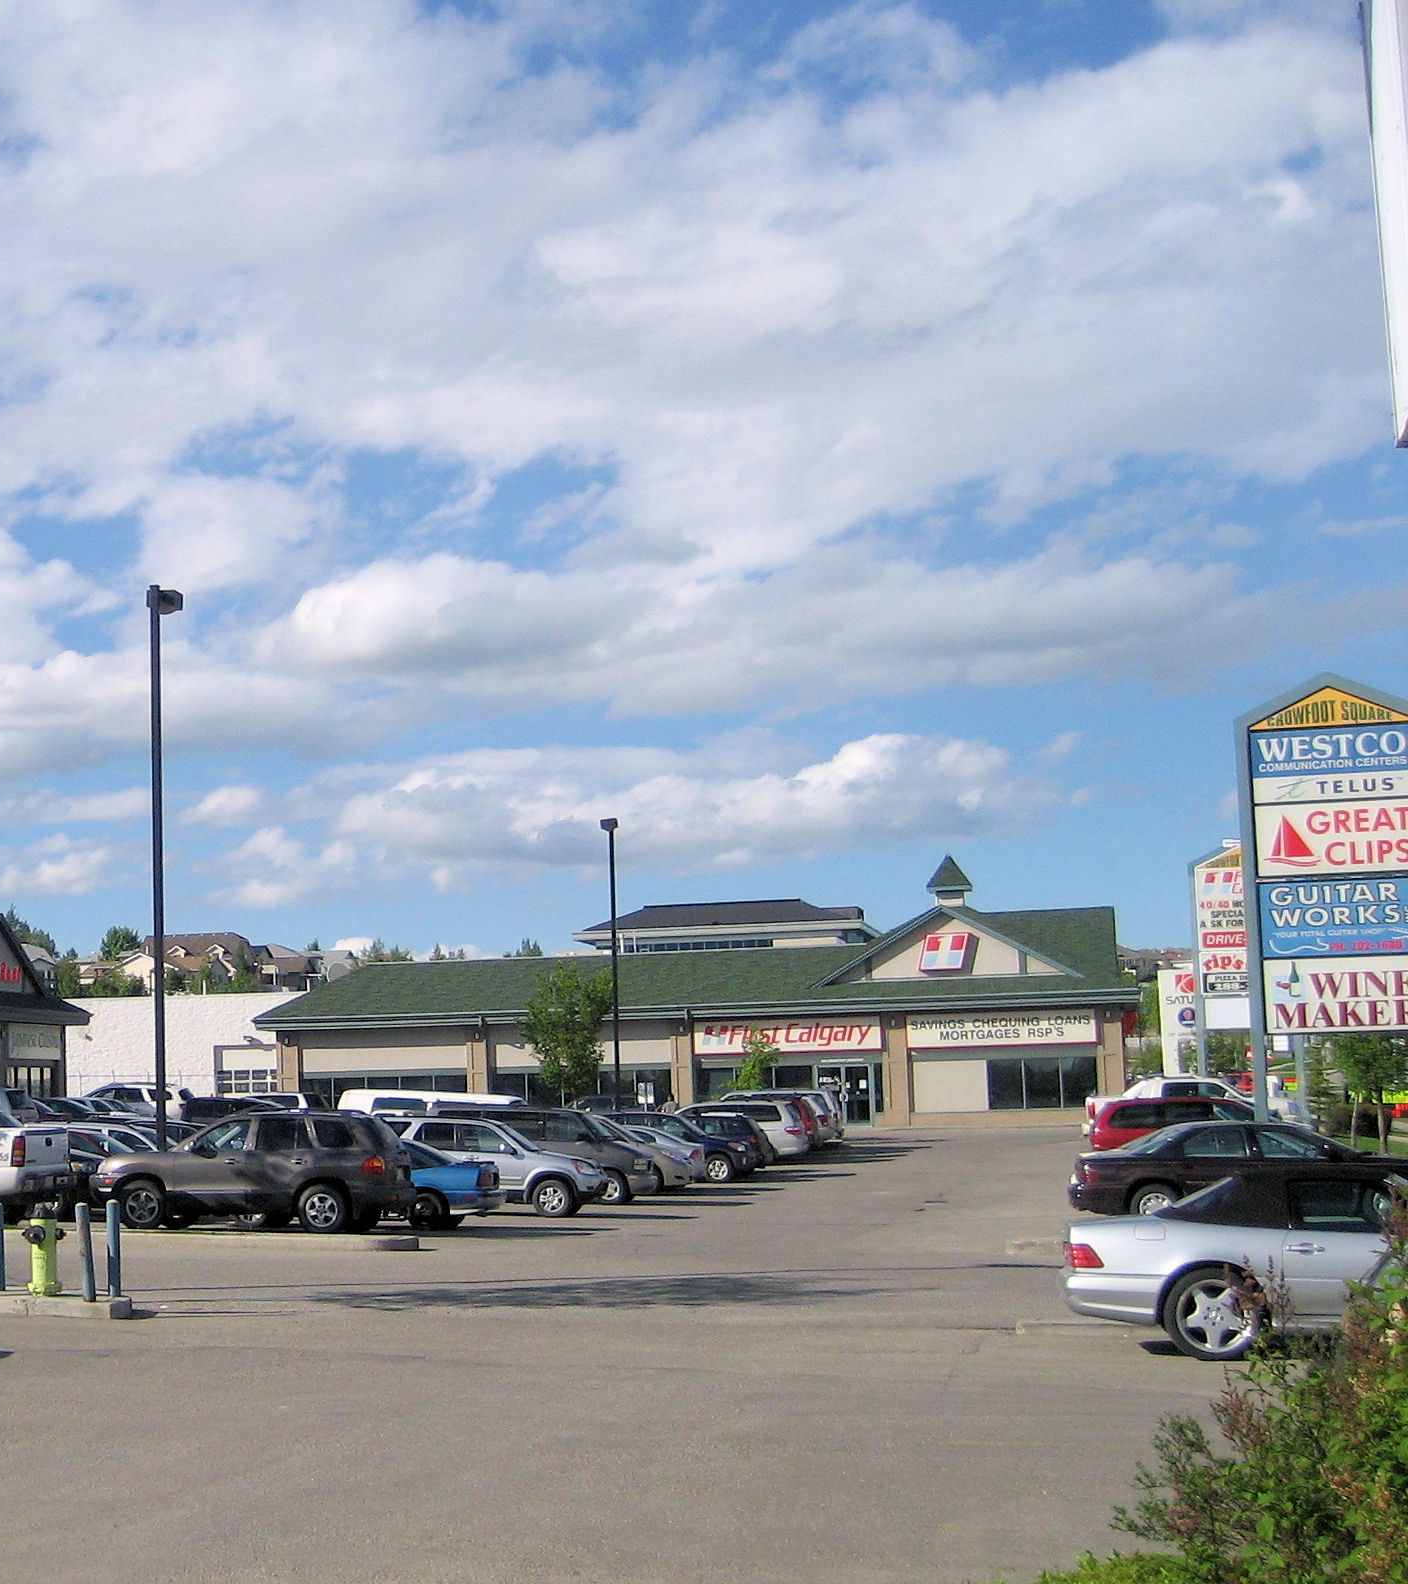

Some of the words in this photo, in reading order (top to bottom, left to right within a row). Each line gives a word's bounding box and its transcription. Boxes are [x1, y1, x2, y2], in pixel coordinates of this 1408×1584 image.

[1267, 700, 1335, 727] CROWFOOT
[1341, 700, 1392, 724] SQUARE
[1257, 730, 1407, 762] WESTCO
[1258, 758, 1353, 773] COMMUNICATION
[1355, 755, 1408, 767] CENTERS
[1316, 777, 1394, 795] TELUS
[1305, 807, 1408, 835] GREAT
[1325, 838, 1408, 866] CLIPS
[1269, 881, 1400, 907] GUITAR
[1210, 910, 1245, 919] SPECIA
[1269, 904, 1401, 929] WORKS
[1206, 933, 1246, 945] DRIVE-
[1307, 970, 1408, 999] WINE
[1165, 995, 1195, 1005] SATU
[728, 1023, 783, 1045] Fist
[785, 1022, 874, 1047] Calgary
[911, 1019, 966, 1031] SAVINGS
[972, 1016, 1040, 1029] CHEQUING
[1047, 1014, 1091, 1026] LOANS
[939, 1027, 1020, 1041] MORTGAGES
[1027, 1026, 1065, 1039] RSP'S
